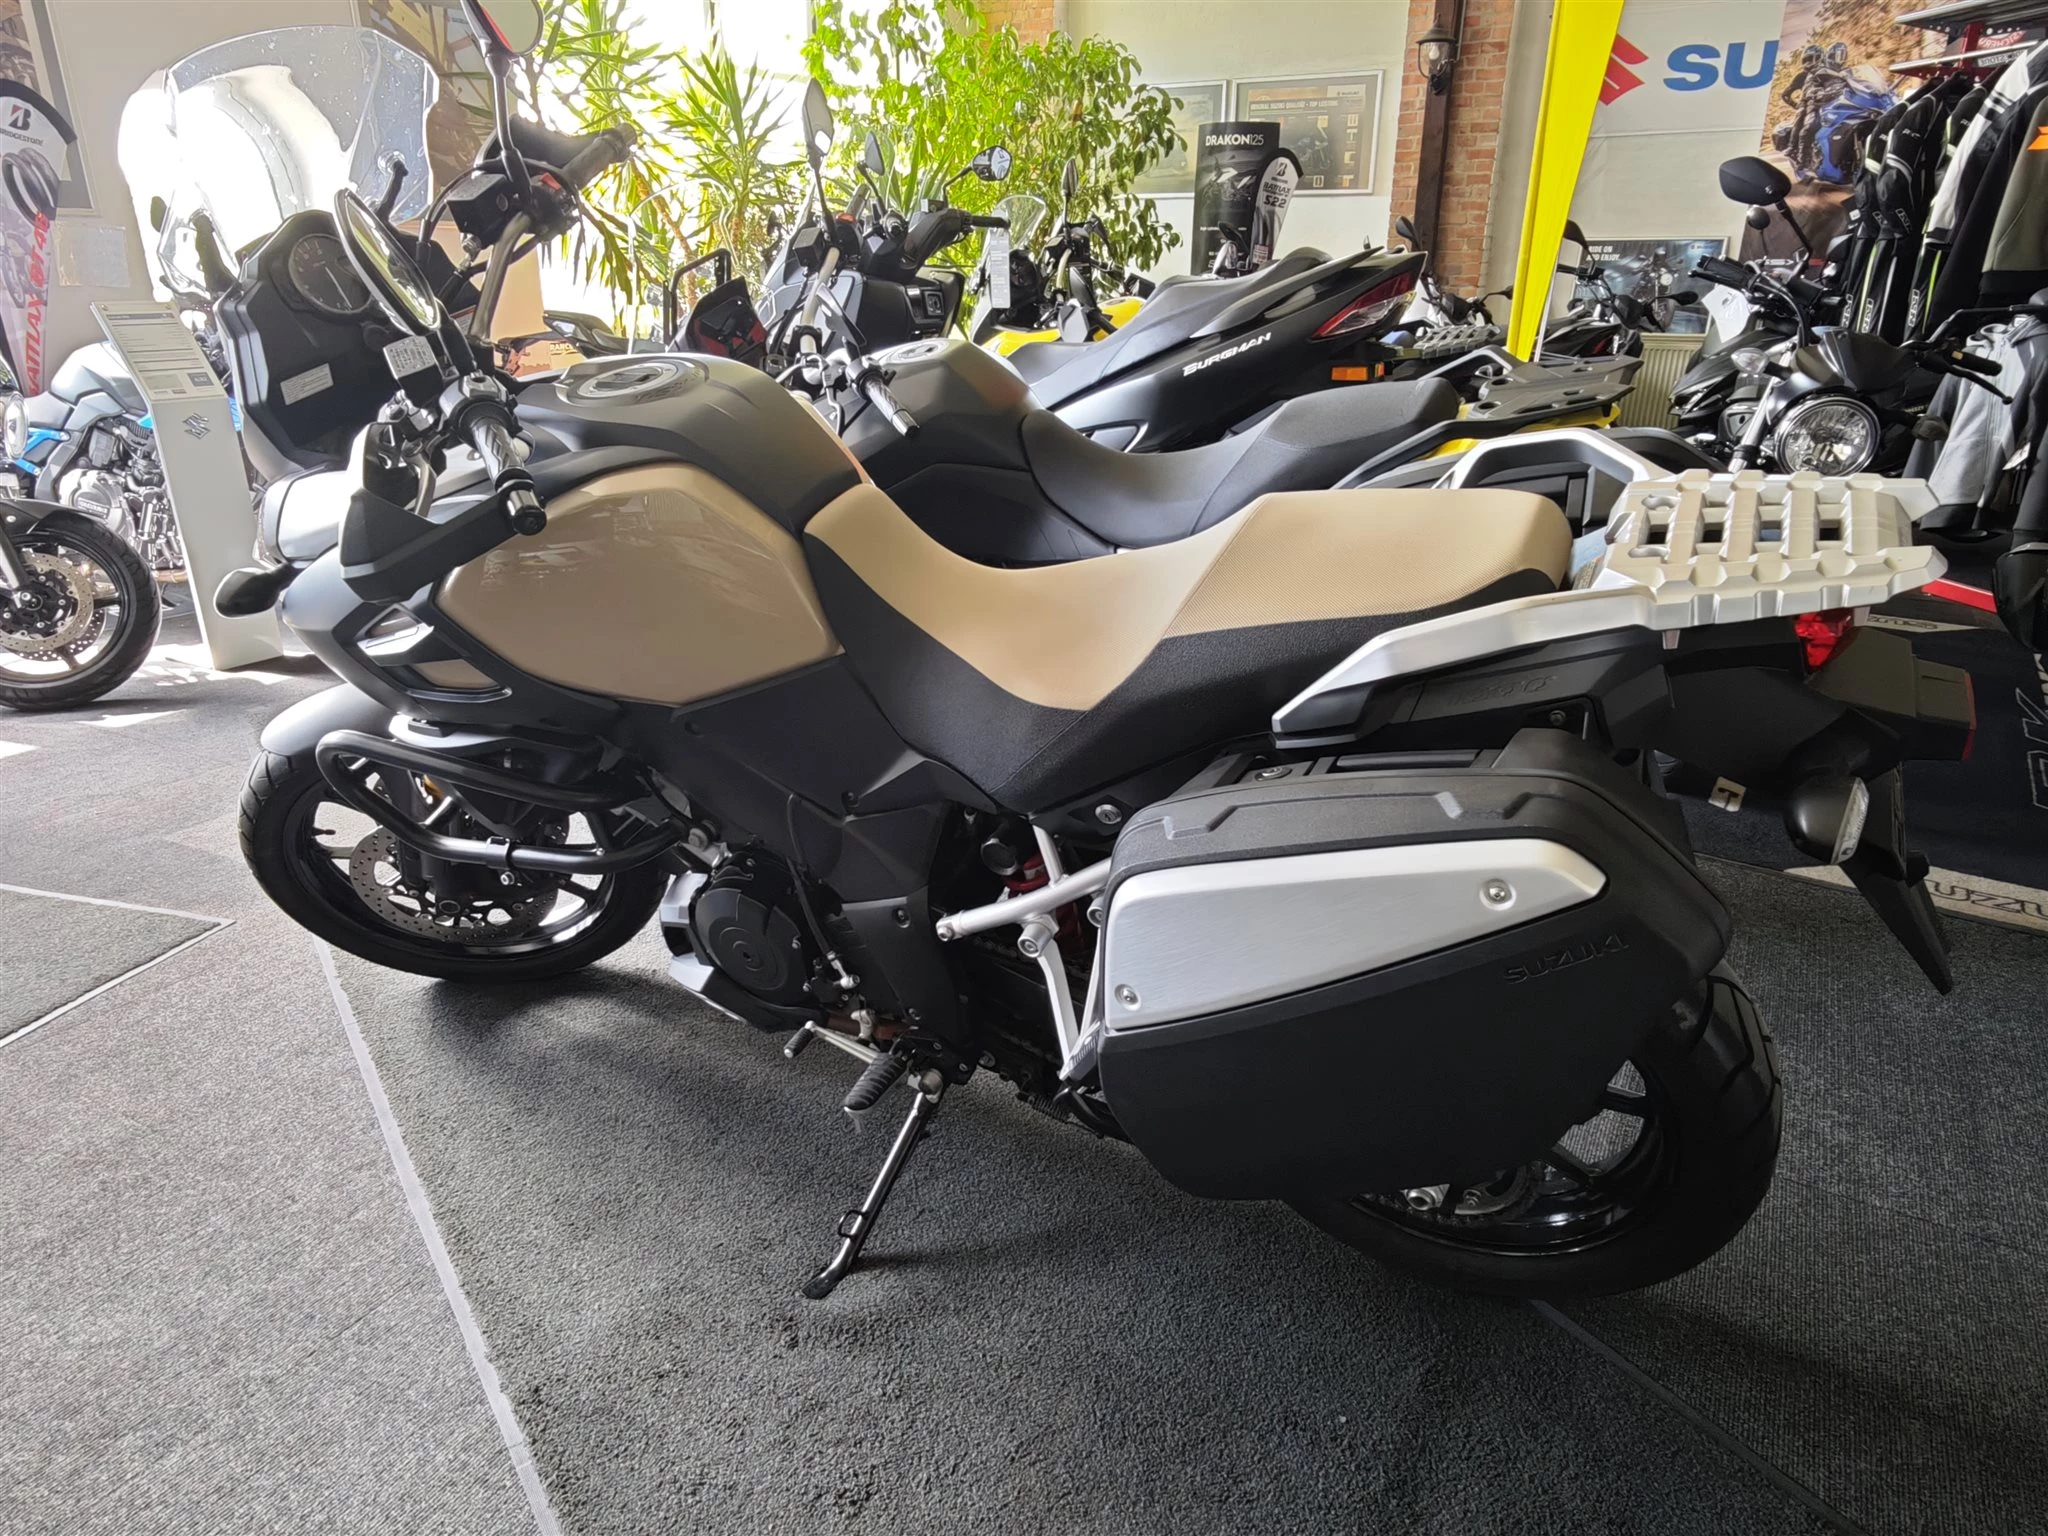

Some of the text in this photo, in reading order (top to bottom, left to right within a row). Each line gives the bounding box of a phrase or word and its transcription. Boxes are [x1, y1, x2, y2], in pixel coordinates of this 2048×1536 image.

[1663, 40, 1780, 91] SU
[1263, 194, 1287, 208] S22
[1182, 332, 1271, 377] BURGMAN
[1502, 932, 1630, 985] SUZUKI
